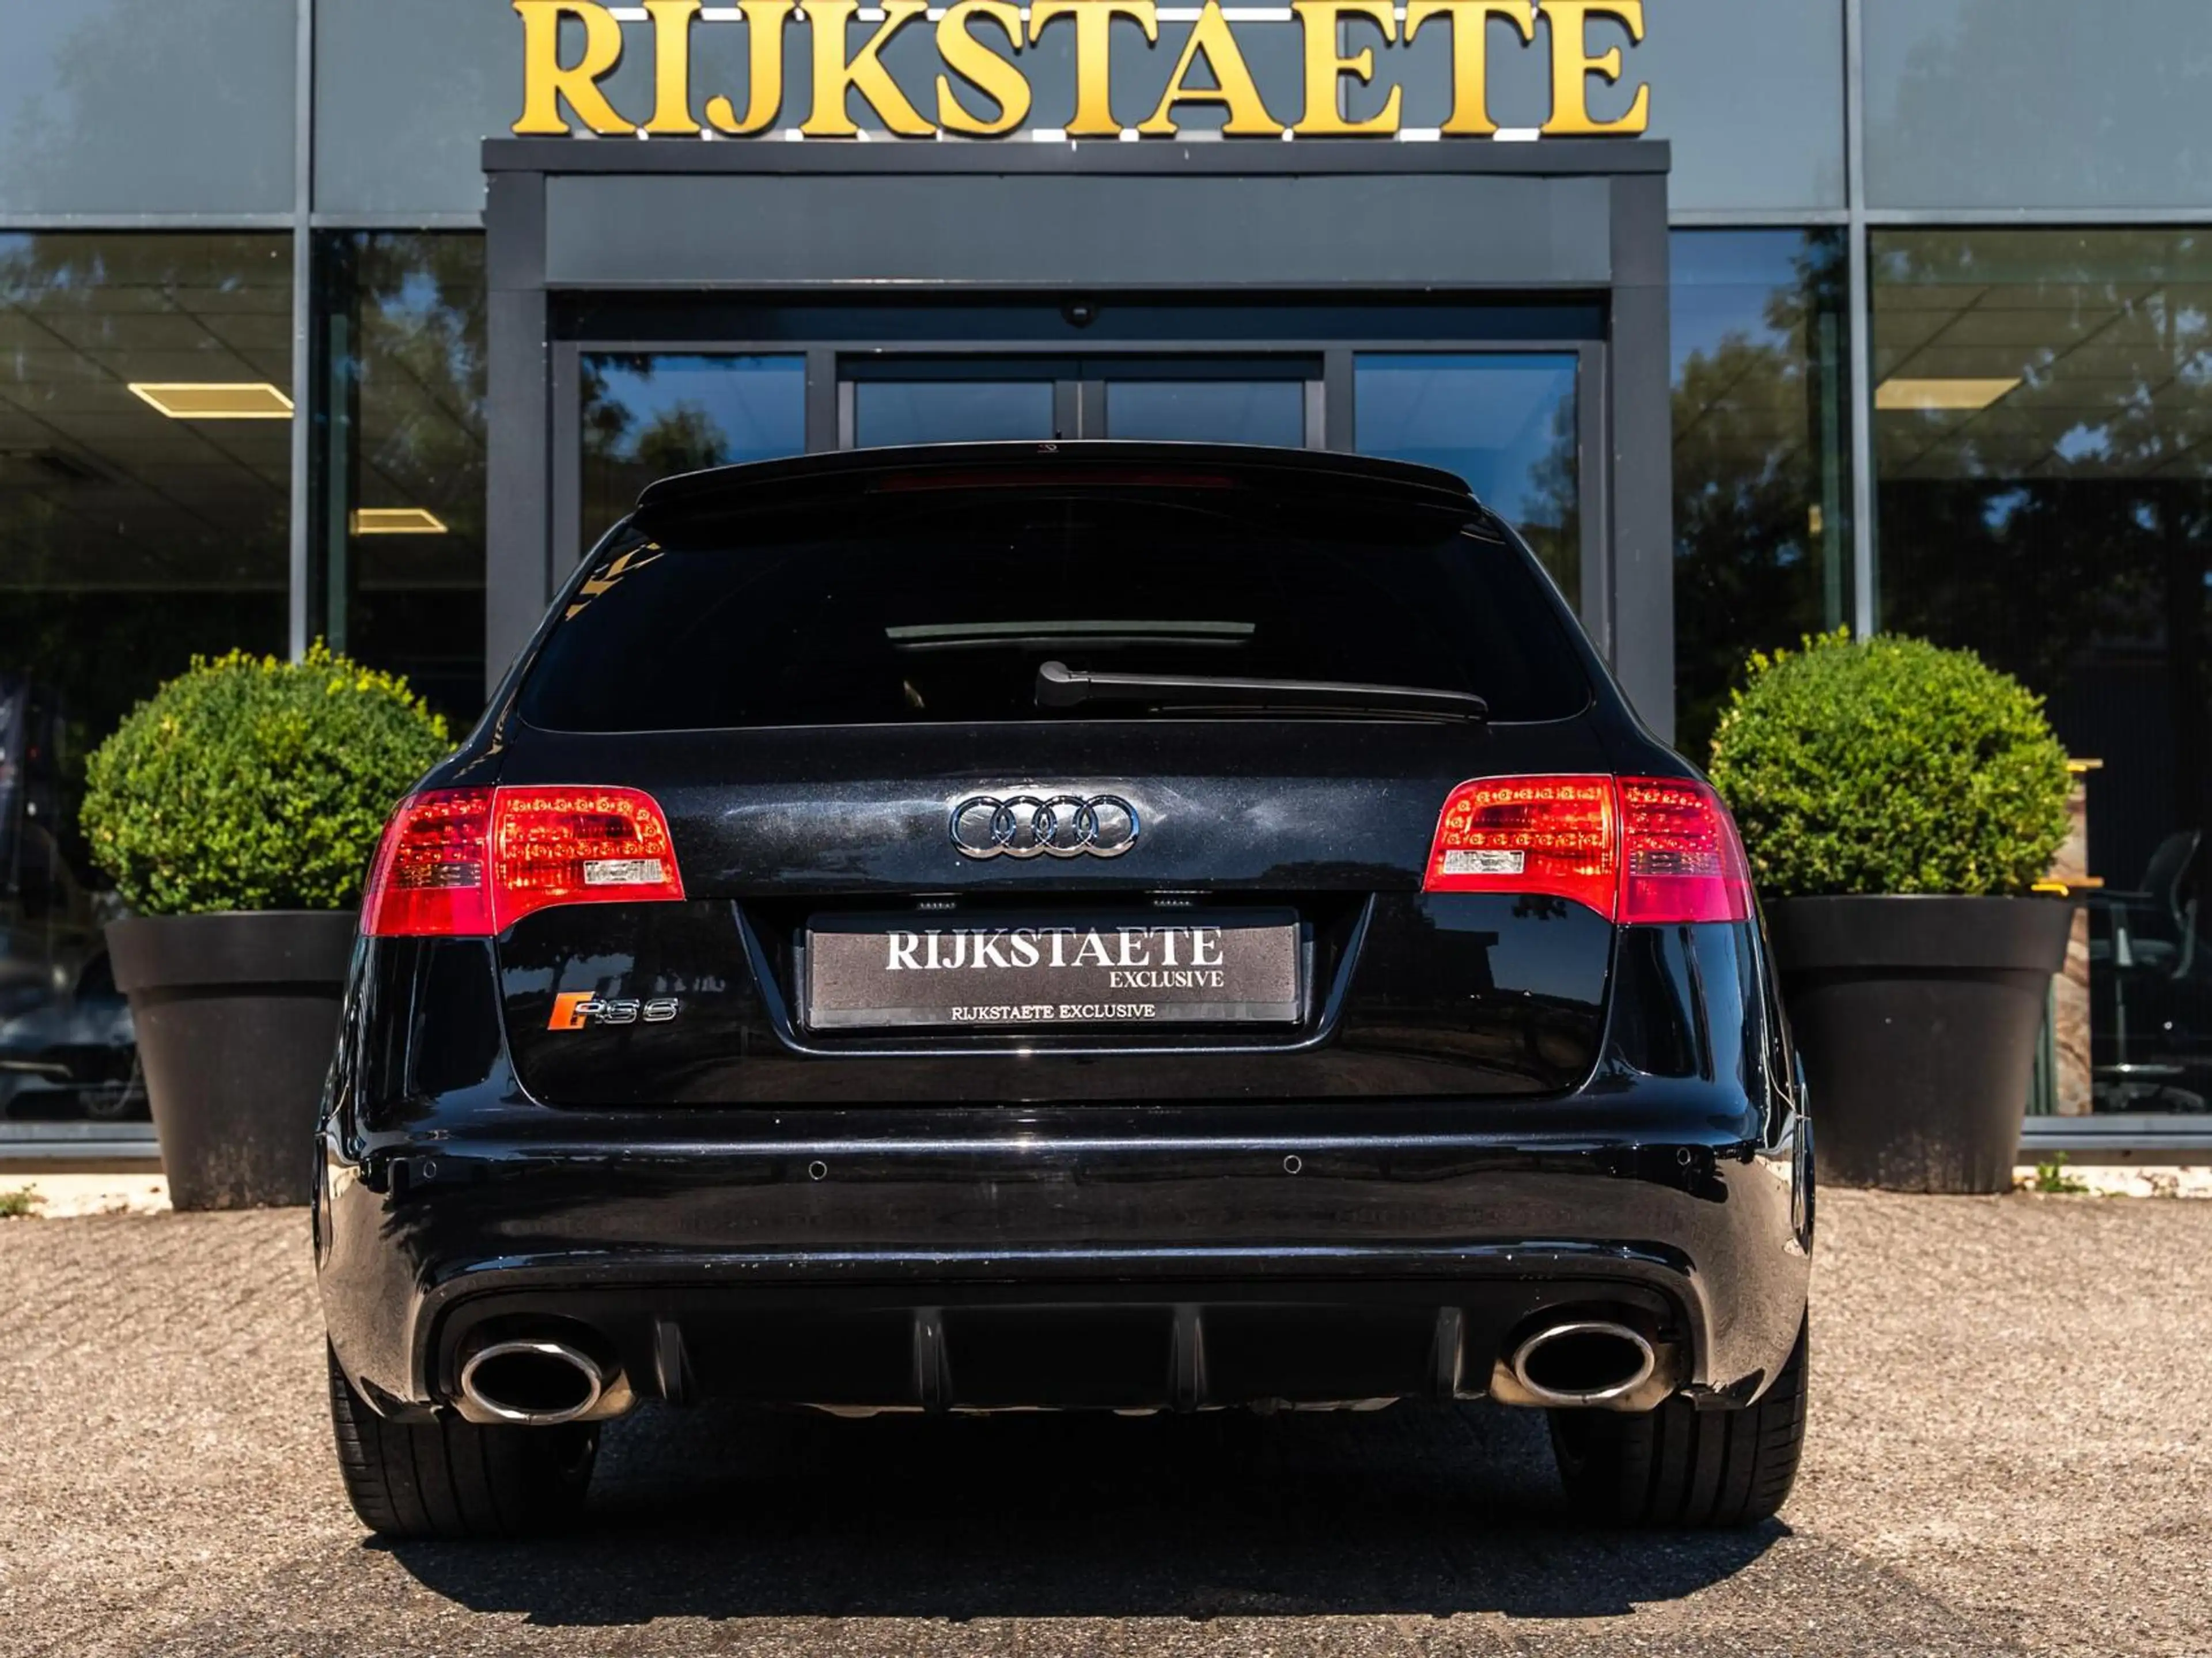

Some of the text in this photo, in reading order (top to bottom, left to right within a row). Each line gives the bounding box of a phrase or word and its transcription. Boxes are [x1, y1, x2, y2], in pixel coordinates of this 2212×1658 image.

[510, 0, 1650, 139] RIJKSTAETE
[885, 926, 1224, 970] RIJKSTAETE
[1109, 970, 1224, 988] EXCLUSIVE
[570, 997, 679, 1026] RS6
[951, 1004, 1156, 1020] RIJKSTAETE EXCLUSIVE
